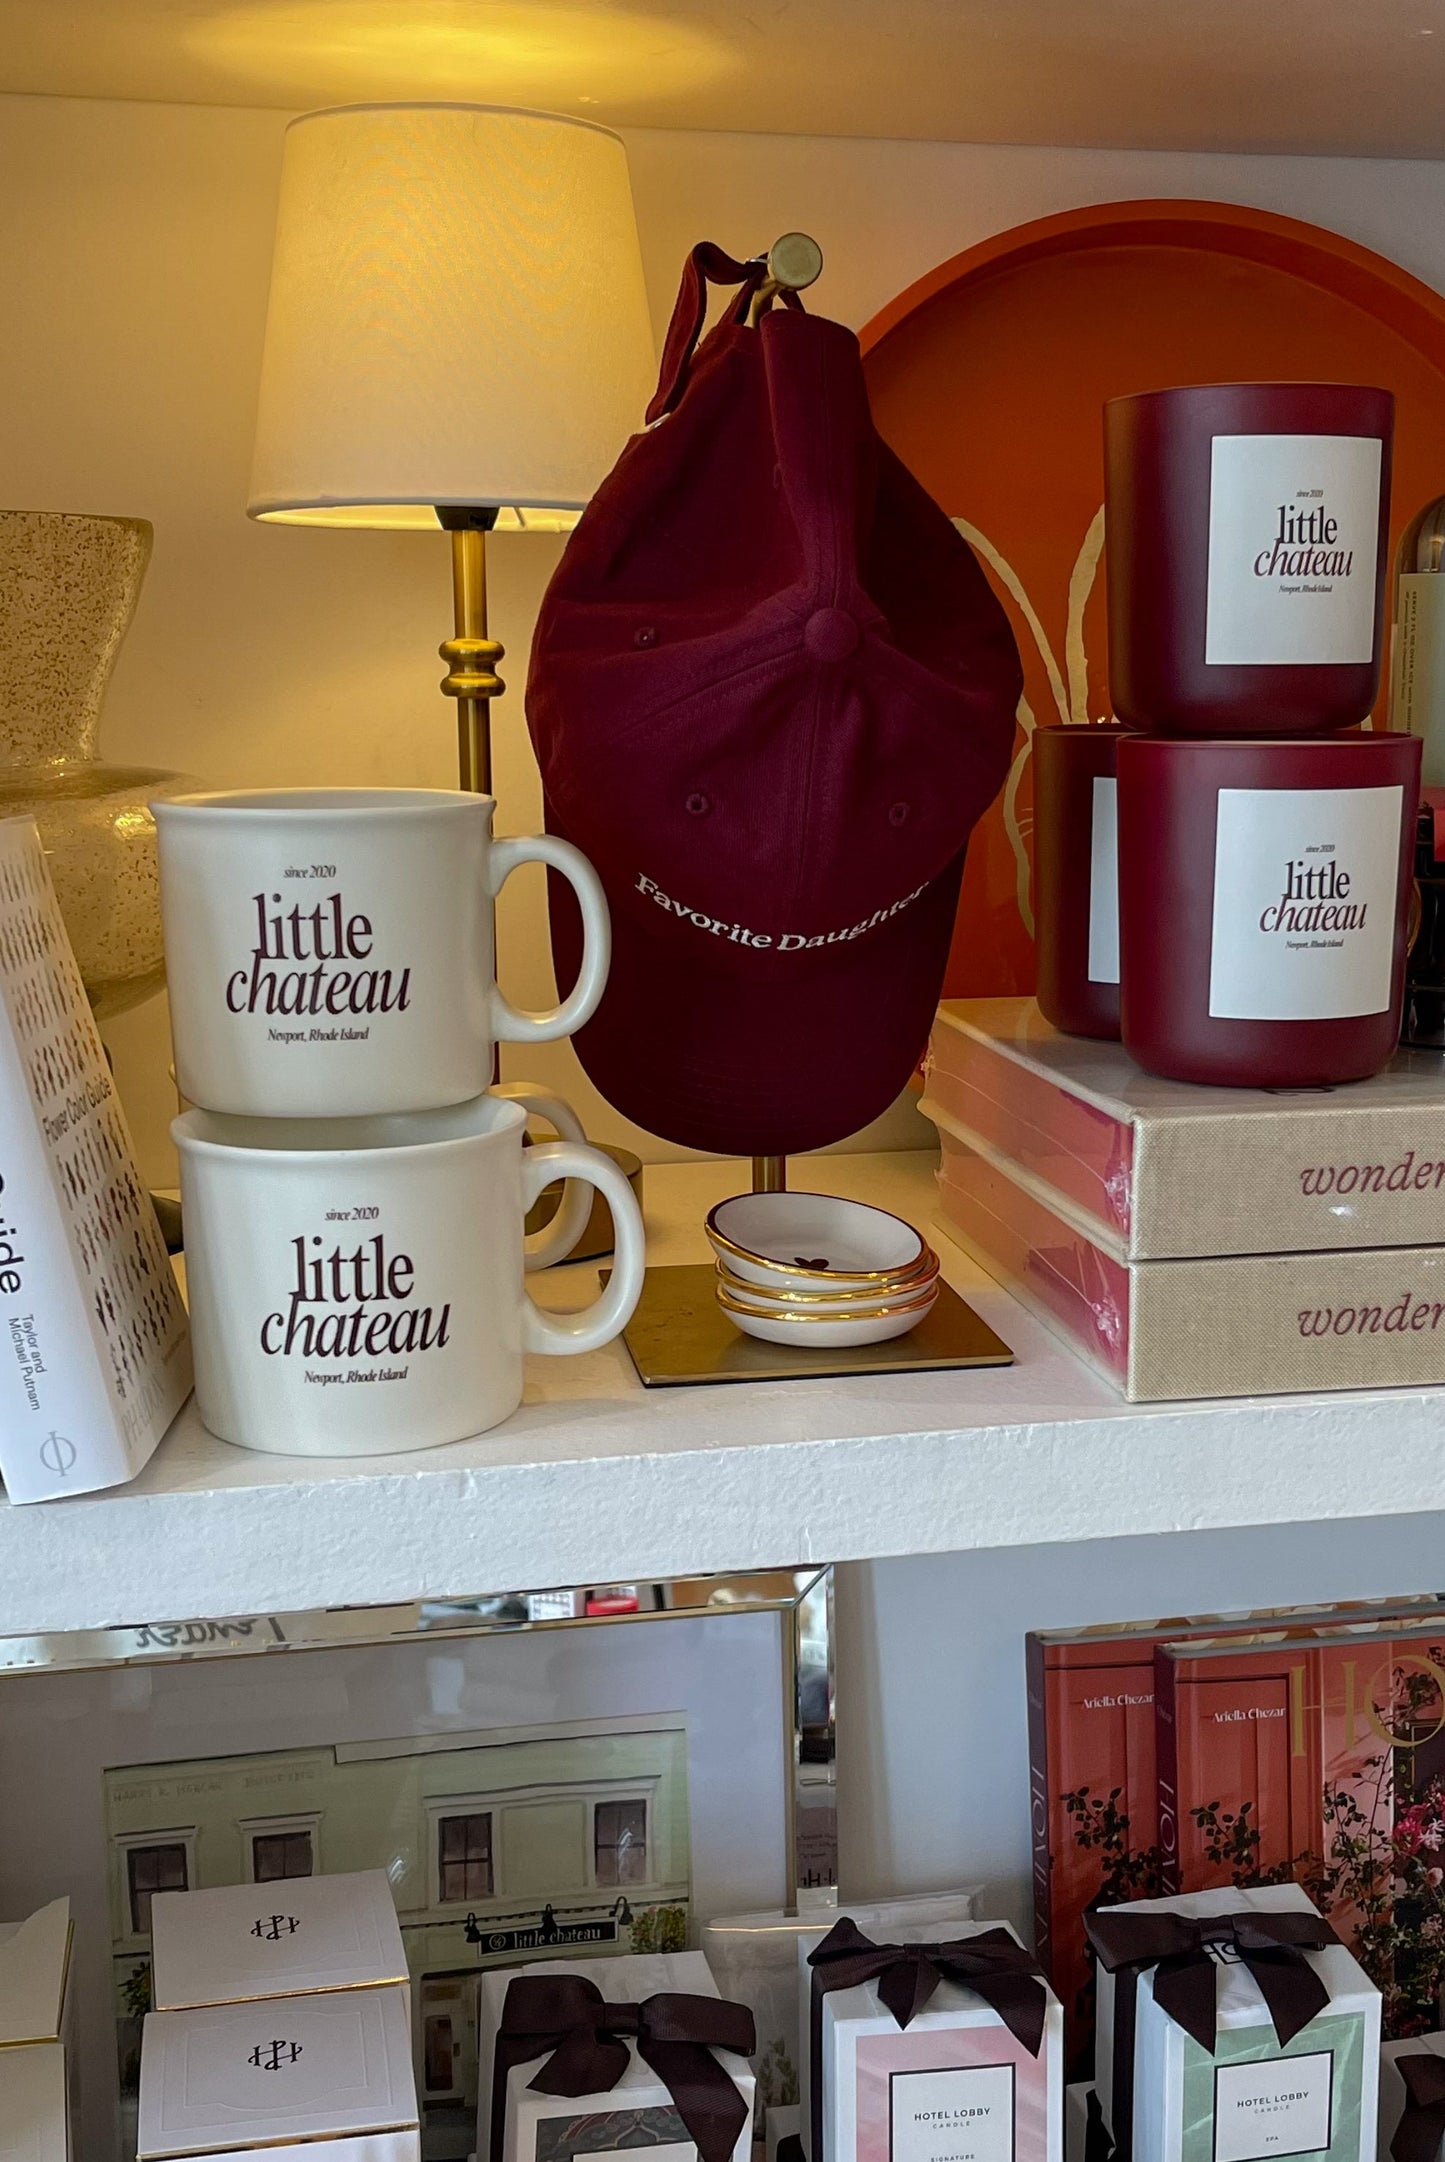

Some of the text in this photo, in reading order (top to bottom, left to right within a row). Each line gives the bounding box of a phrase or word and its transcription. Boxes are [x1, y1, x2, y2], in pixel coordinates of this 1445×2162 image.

[1277, 504, 1338, 545] little
[1253, 537, 1353, 577] chateau
[283, 865, 337, 879] since 2020
[1284, 859, 1351, 900] little
[252, 892, 373, 961] little
[634, 872, 930, 951] Favorite Daughter
[1259, 893, 1368, 932] chateau
[226, 948, 411, 1016] chateau
[267, 1026, 370, 1045] Newport, Rhode Island
[1300, 1151, 1445, 1196] wonder
[324, 1206, 380, 1221] since 2020
[290, 1233, 415, 1303] little
[260, 1290, 451, 1358] chateau
[1297, 1293, 1445, 1337] wonder
[8, 1317, 41, 1411] Michael Putnam
[22, 1314, 47, 1374] Taylor and
[304, 1366, 409, 1387] Newport, Rhode Island
[1213, 1707, 1286, 1723] Ariella Chezar
[513, 1927, 601, 1949] little chateau
[914, 2107, 990, 2121] HOTEL LOBBY
[1237, 2091, 1309, 2108] HOTEL LOBBY
[932, 2120, 970, 2129] CANDLE
